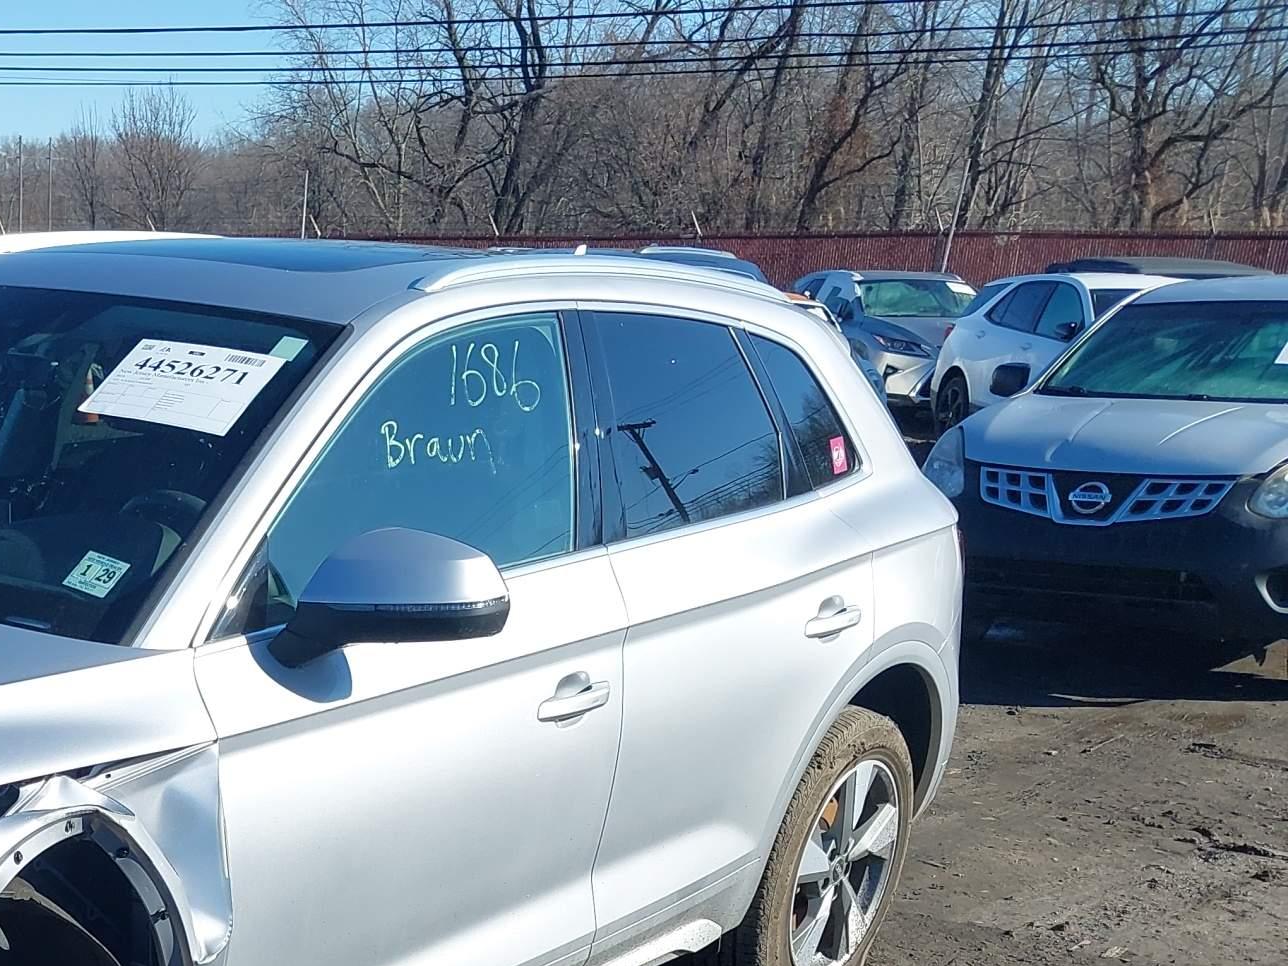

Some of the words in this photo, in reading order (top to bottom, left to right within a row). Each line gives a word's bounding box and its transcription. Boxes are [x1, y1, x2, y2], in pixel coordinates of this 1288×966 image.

[134, 356, 249, 385] 44526271
[450, 341, 540, 411] 1686
[381, 421, 496, 474] Braun
[80, 564, 93, 577] 1
[95, 568, 116, 584] 29
